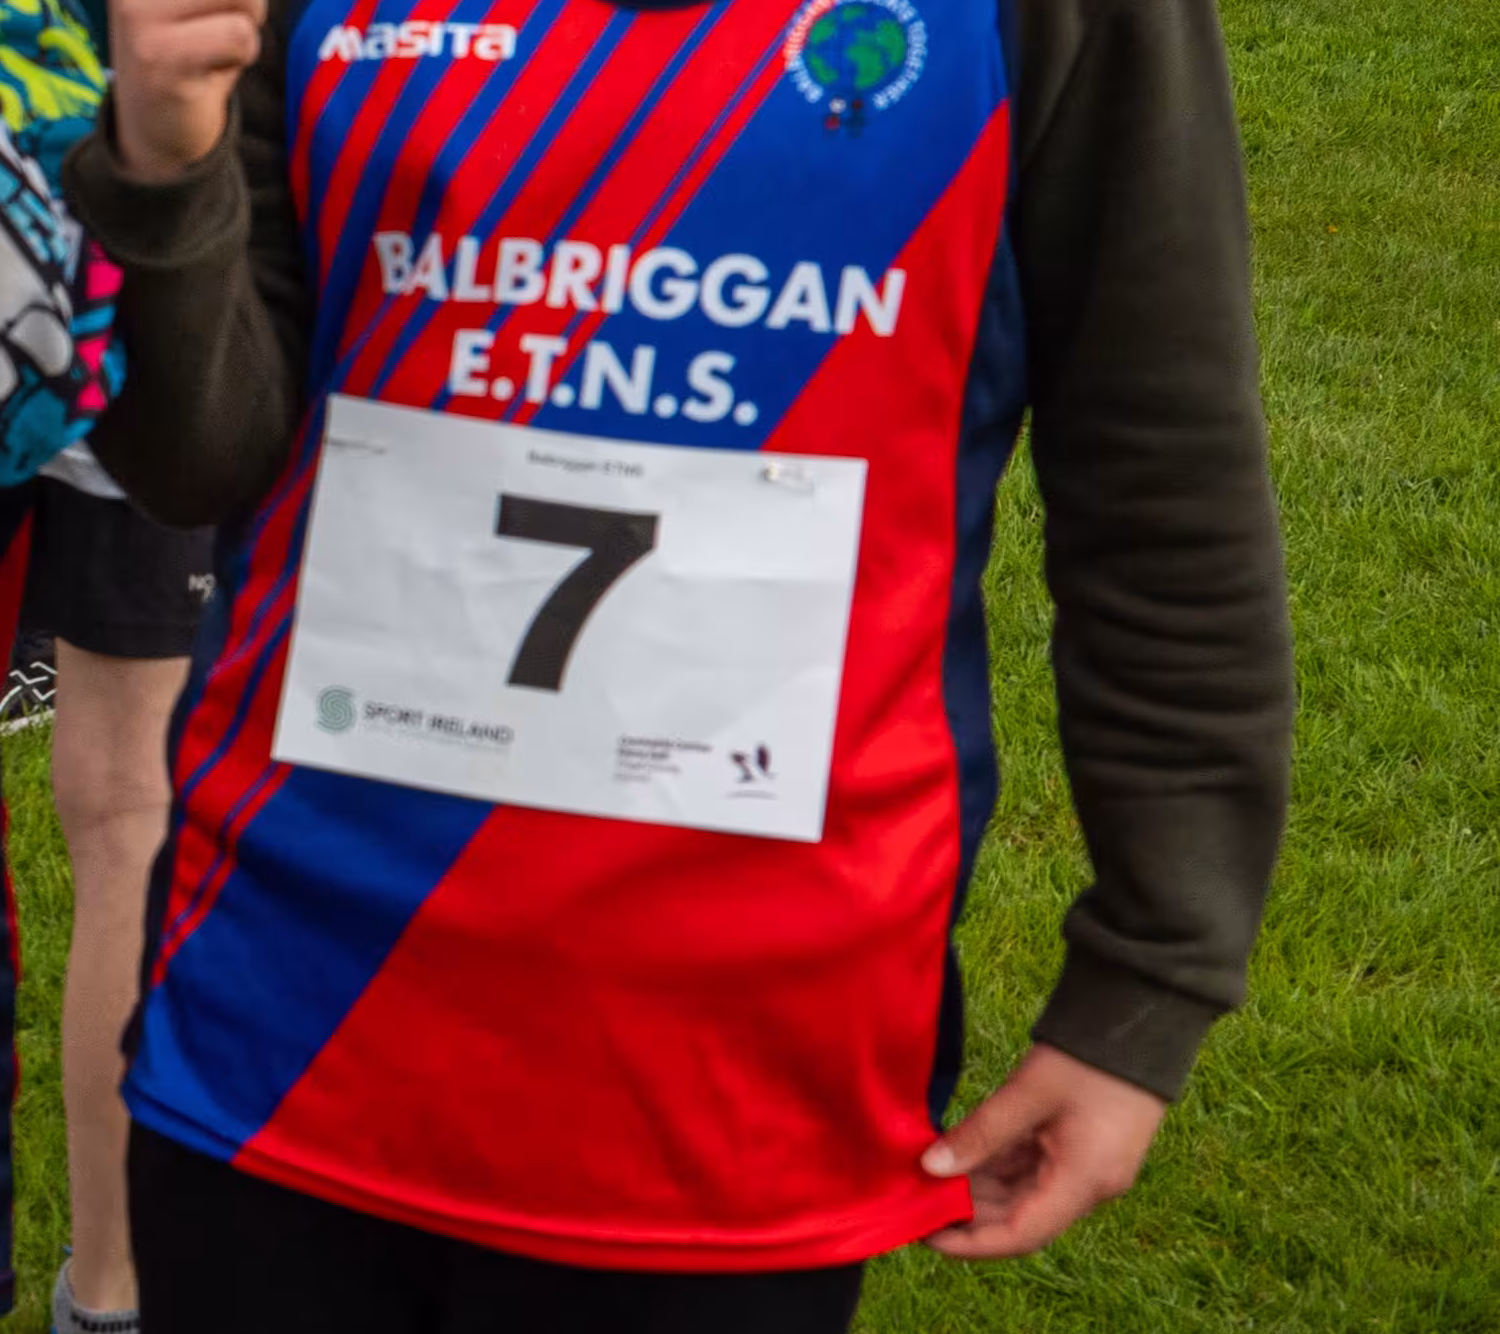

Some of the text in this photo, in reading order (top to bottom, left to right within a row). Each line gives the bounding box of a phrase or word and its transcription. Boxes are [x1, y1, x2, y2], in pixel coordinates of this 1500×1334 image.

[373, 230, 907, 338] BALBRIGGAN
[445, 327, 760, 427] E.T.N.S.
[492, 492, 659, 694] 7
[363, 701, 516, 745] SPORT IRELAND
